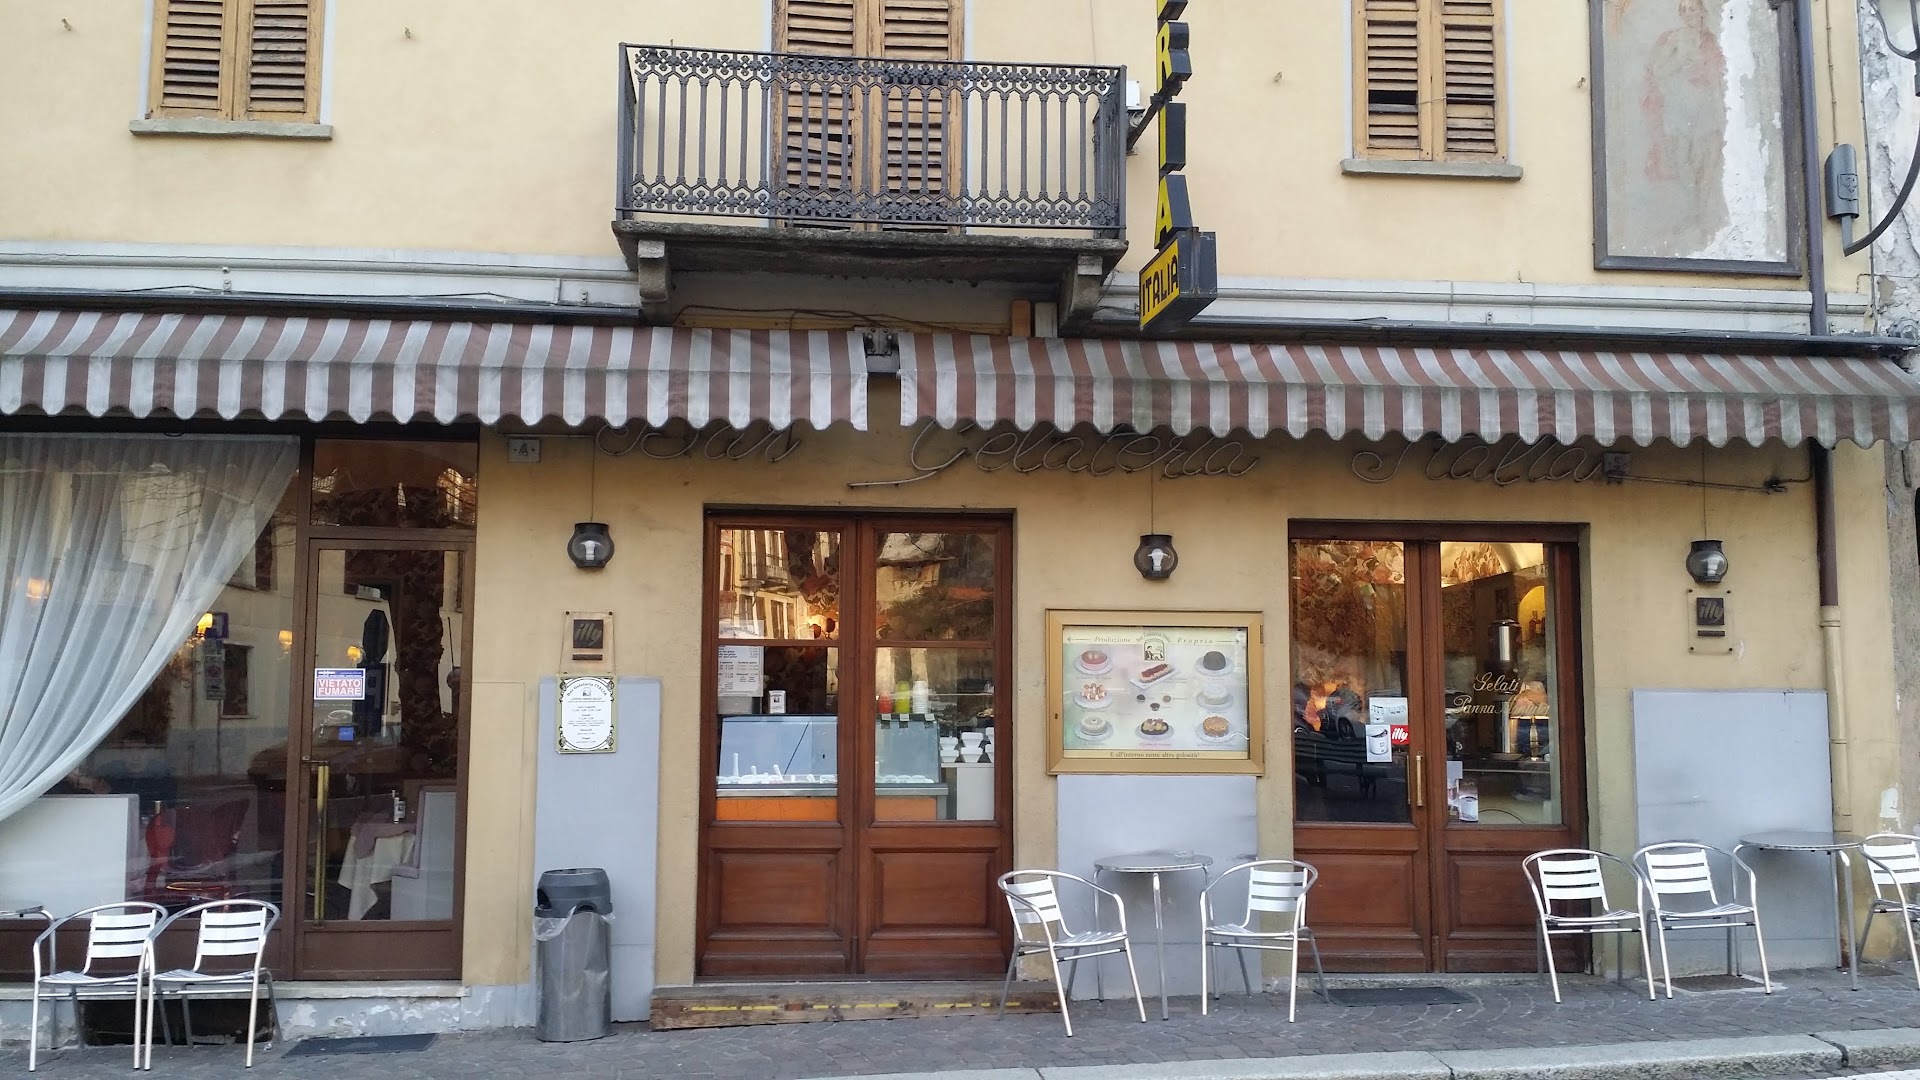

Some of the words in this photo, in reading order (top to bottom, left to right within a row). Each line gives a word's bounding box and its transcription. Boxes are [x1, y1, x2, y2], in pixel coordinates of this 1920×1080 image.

[1142, 254, 1178, 317] ITALIA
[1177, 637, 1213, 645] Propria
[319, 679, 361, 687] VIETATO
[1473, 672, 1520, 692] Gelati
[318, 687, 361, 695] FUMARE
[1453, 694, 1496, 714] Panna
[1391, 728, 1409, 743] illy
